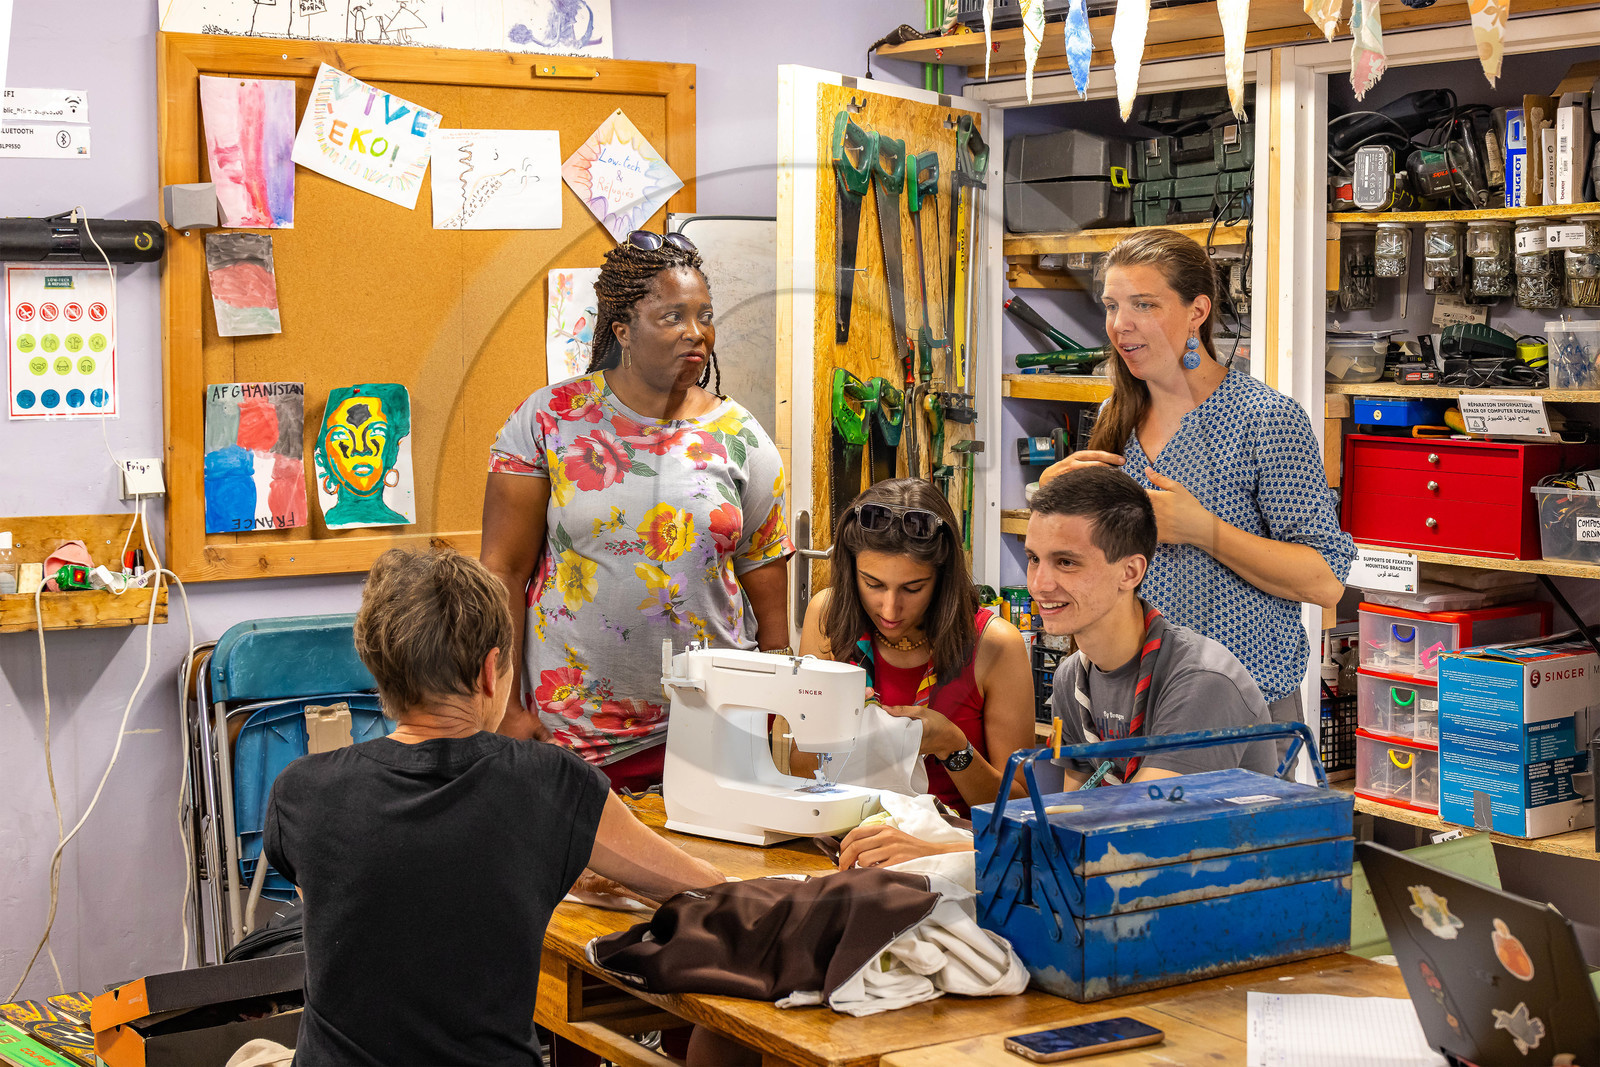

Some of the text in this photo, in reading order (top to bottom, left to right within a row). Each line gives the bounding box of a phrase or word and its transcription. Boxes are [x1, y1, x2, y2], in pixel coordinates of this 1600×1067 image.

[328, 119, 399, 168] EKO!
[598, 148, 640, 172] Low-tech
[616, 170, 623, 182] &
[231, 512, 295, 530] FRANCE
[1545, 668, 1584, 682] SINGER
